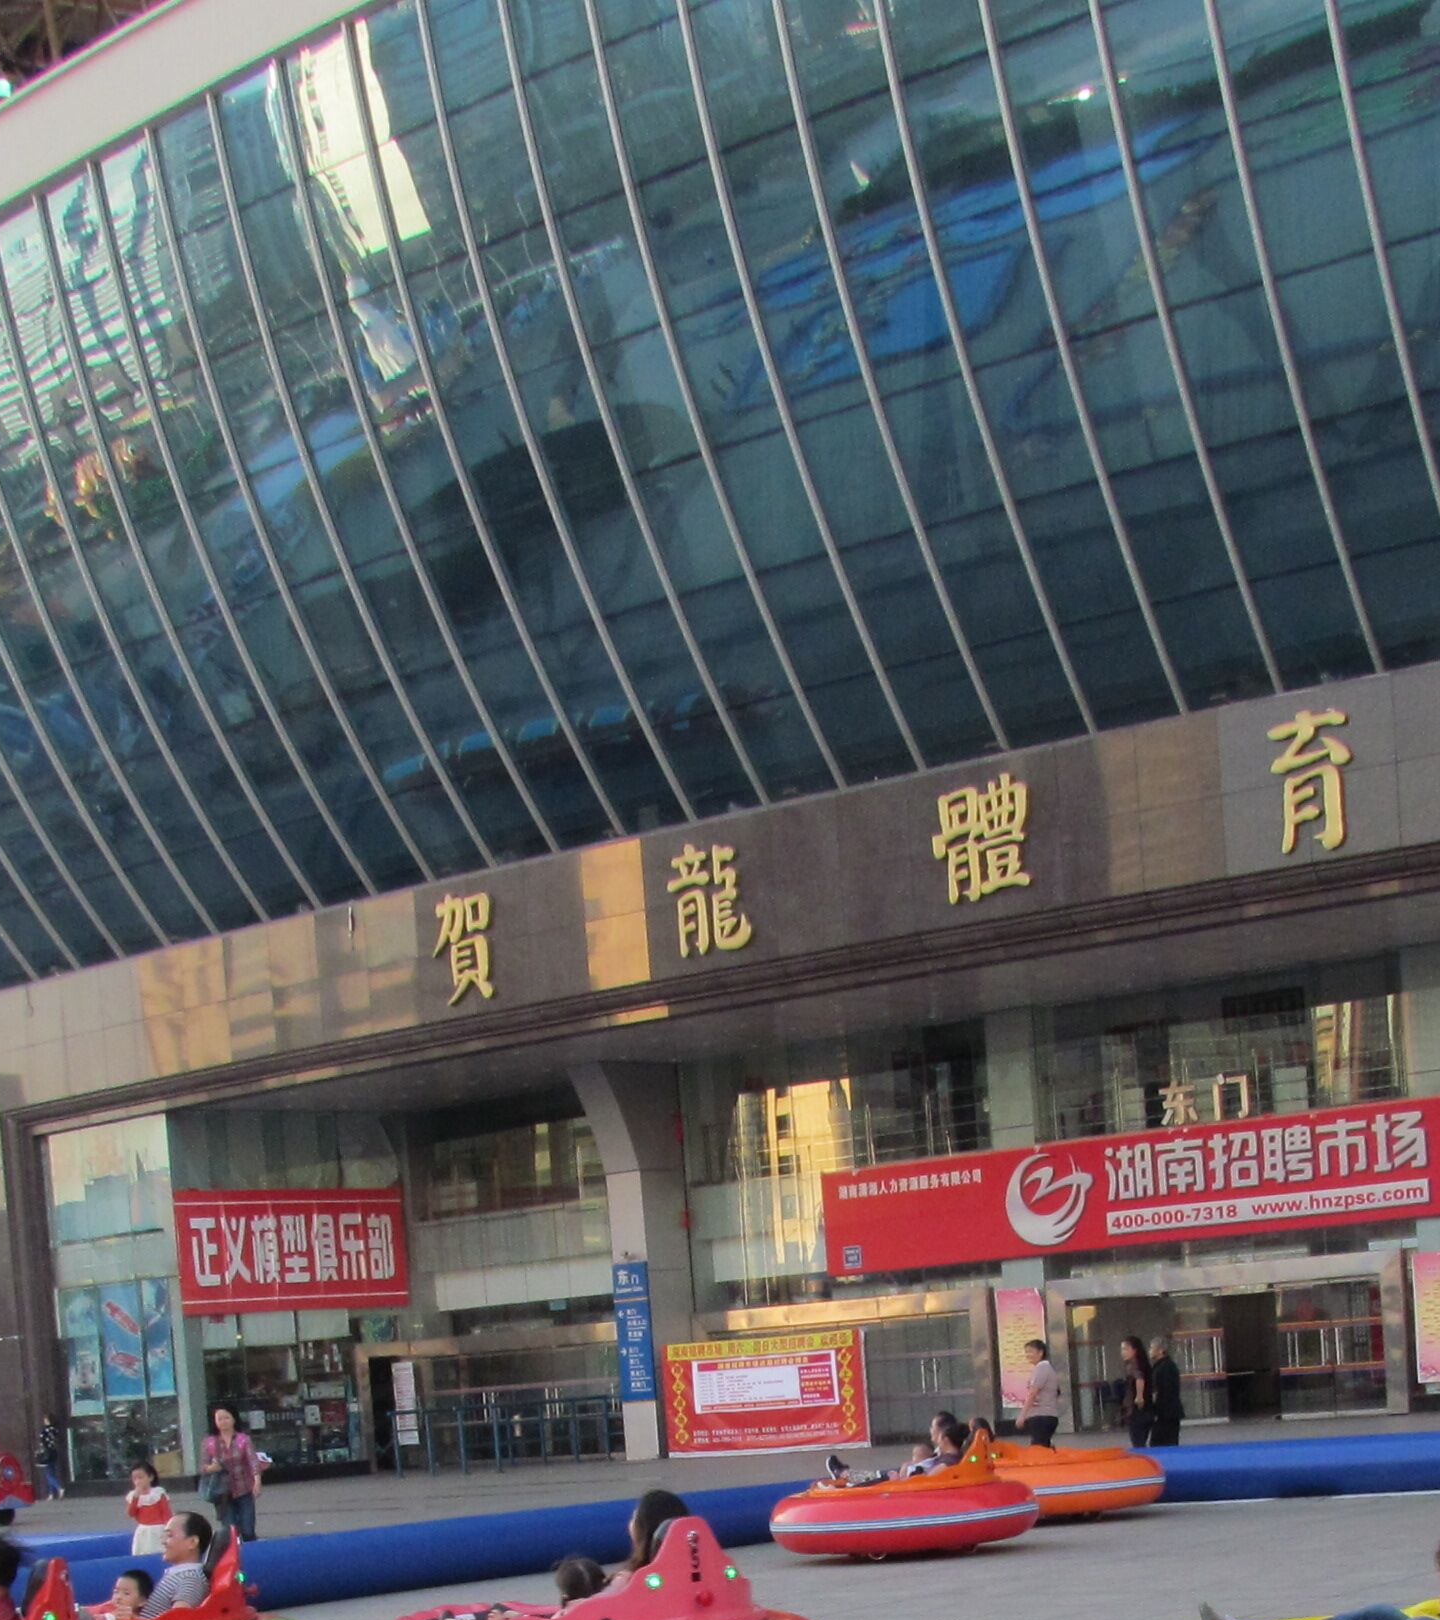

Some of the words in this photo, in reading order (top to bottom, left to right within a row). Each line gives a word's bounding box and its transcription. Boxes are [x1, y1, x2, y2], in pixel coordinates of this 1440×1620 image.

[1158, 1073, 1249, 1125] 东门
[1104, 1110, 1430, 1201] 湖南招聘市场
[1110, 1203, 1238, 1232] 400-000-7318
[1251, 1181, 1425, 1216] www.hnzpsc.com
[189, 1213, 397, 1287] 正义模型俱乐部
